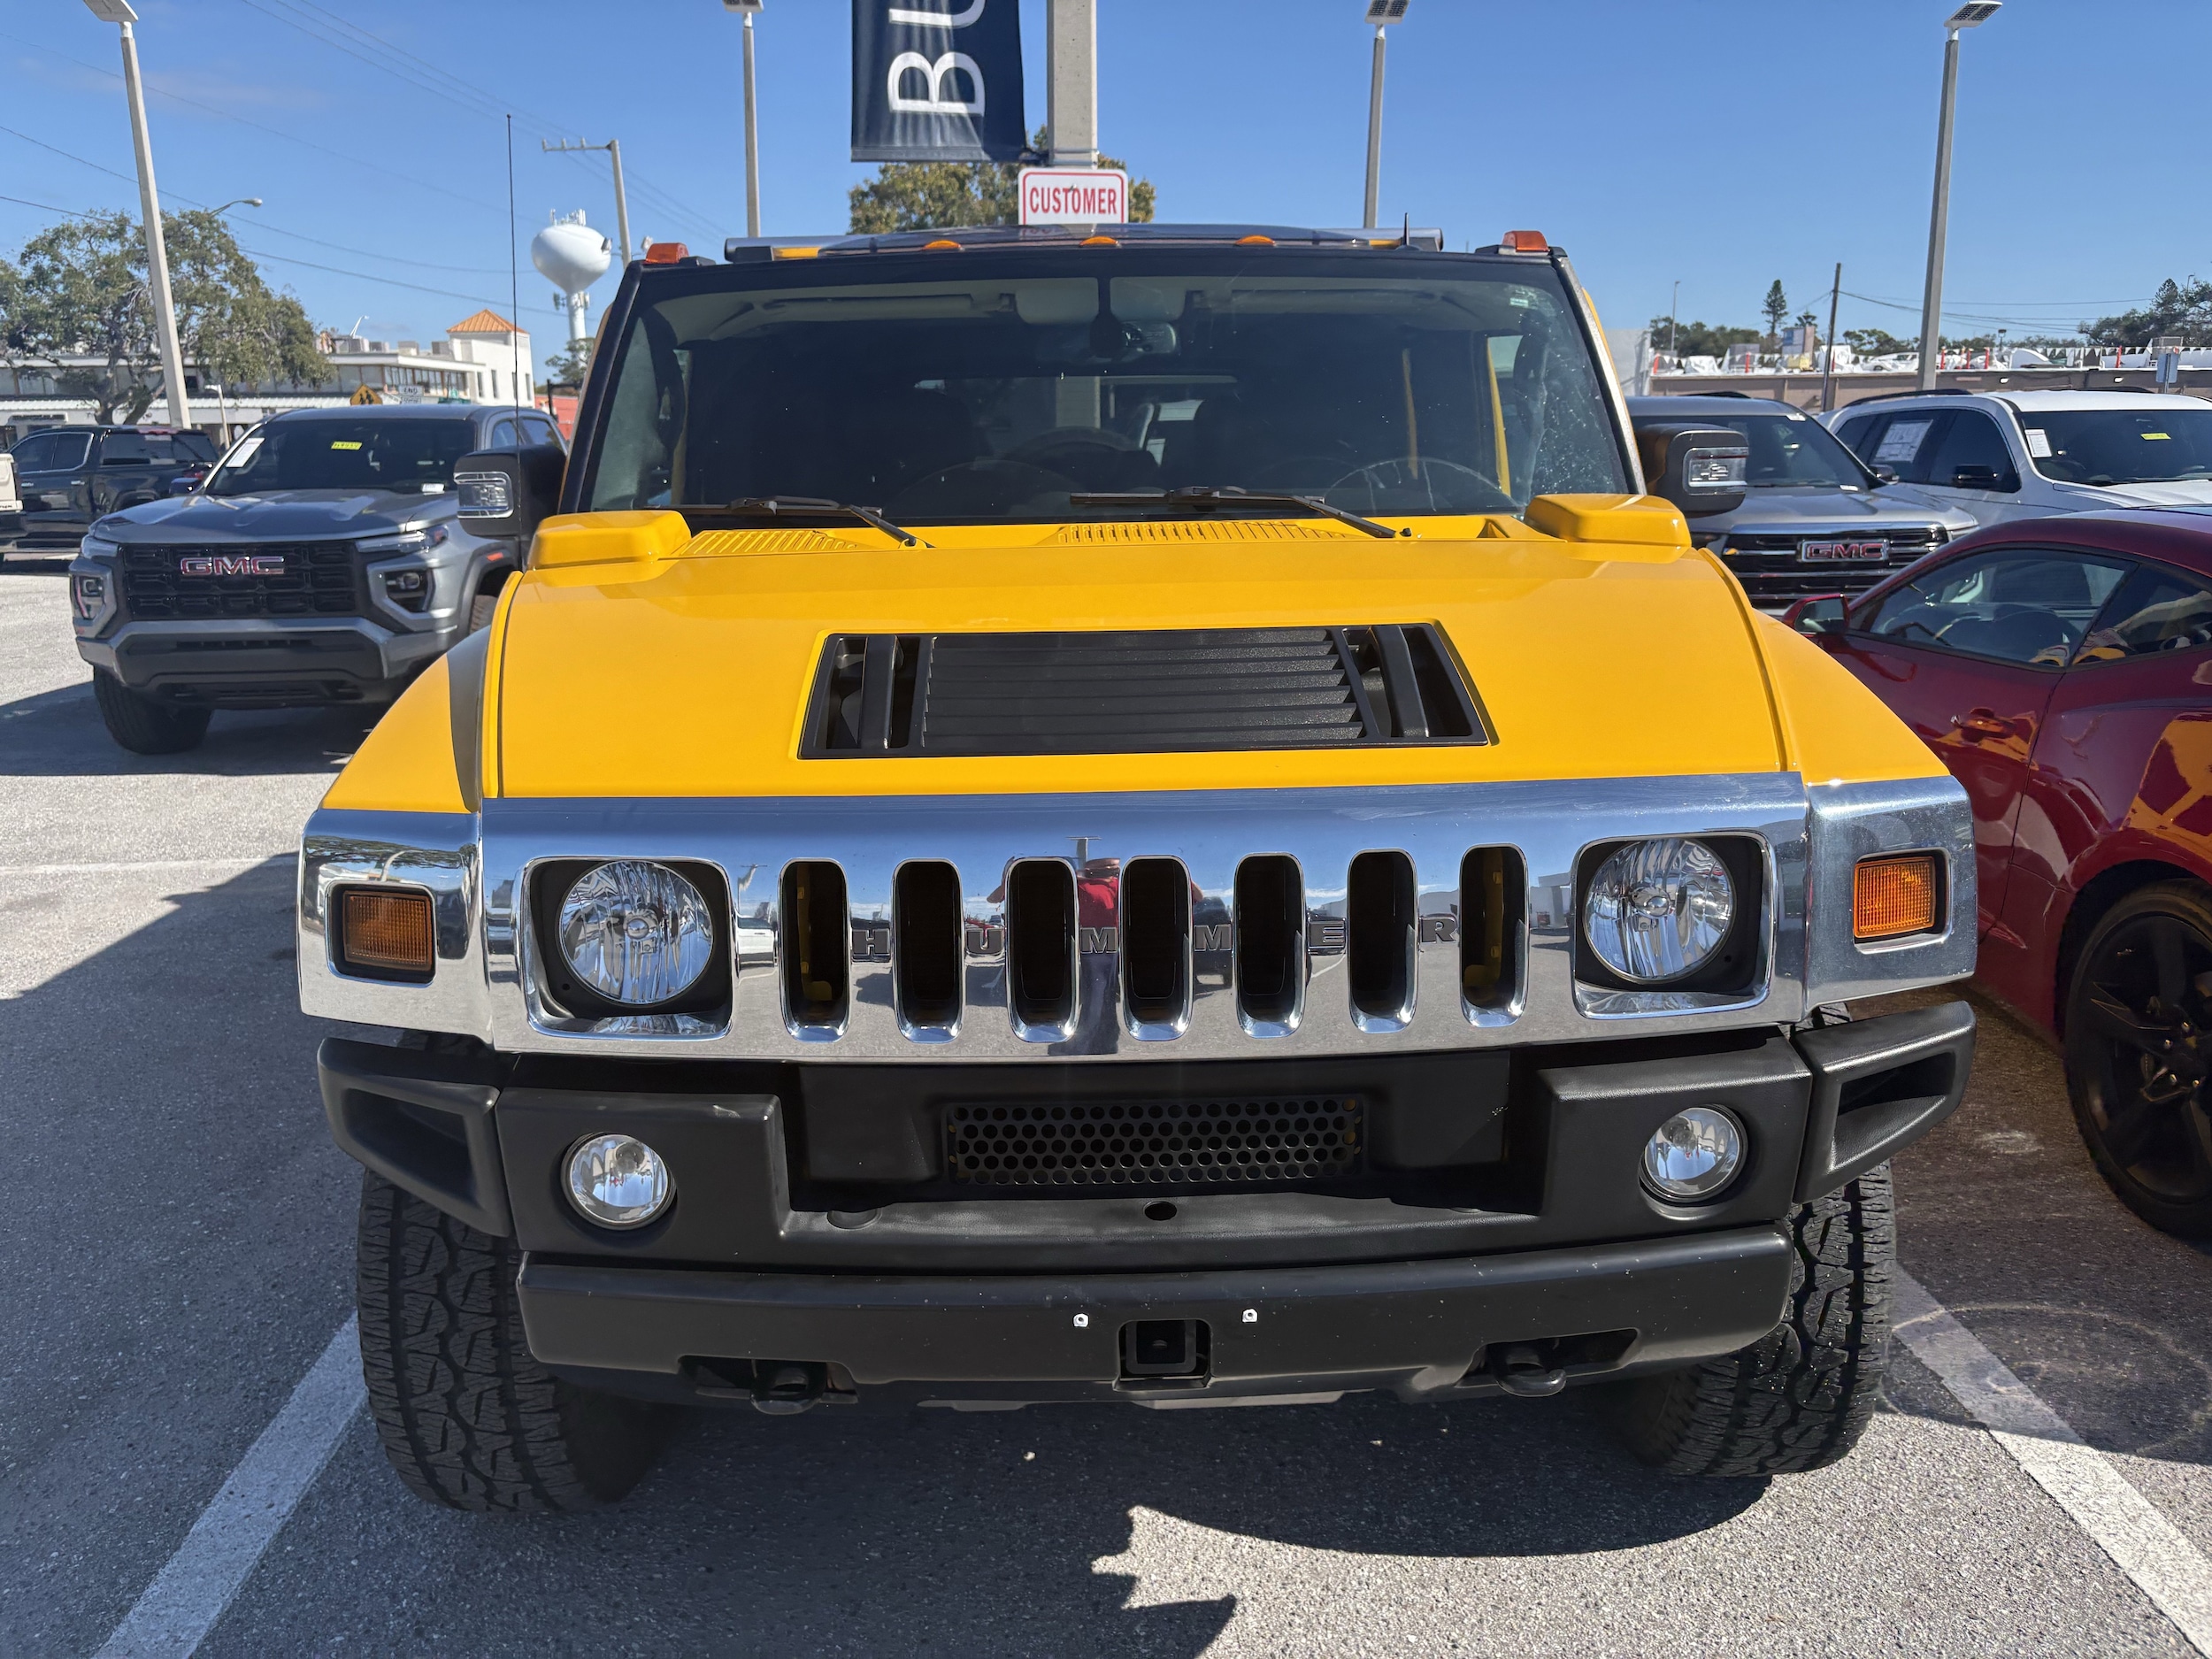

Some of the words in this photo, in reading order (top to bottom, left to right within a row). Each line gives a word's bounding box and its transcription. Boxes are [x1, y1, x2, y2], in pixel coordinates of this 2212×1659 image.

[1029, 186, 1118, 215] CUSTOMER
[1806, 542, 1884, 559] GMC
[180, 555, 286, 576] GMC
[850, 916, 1458, 956] HUMMER
